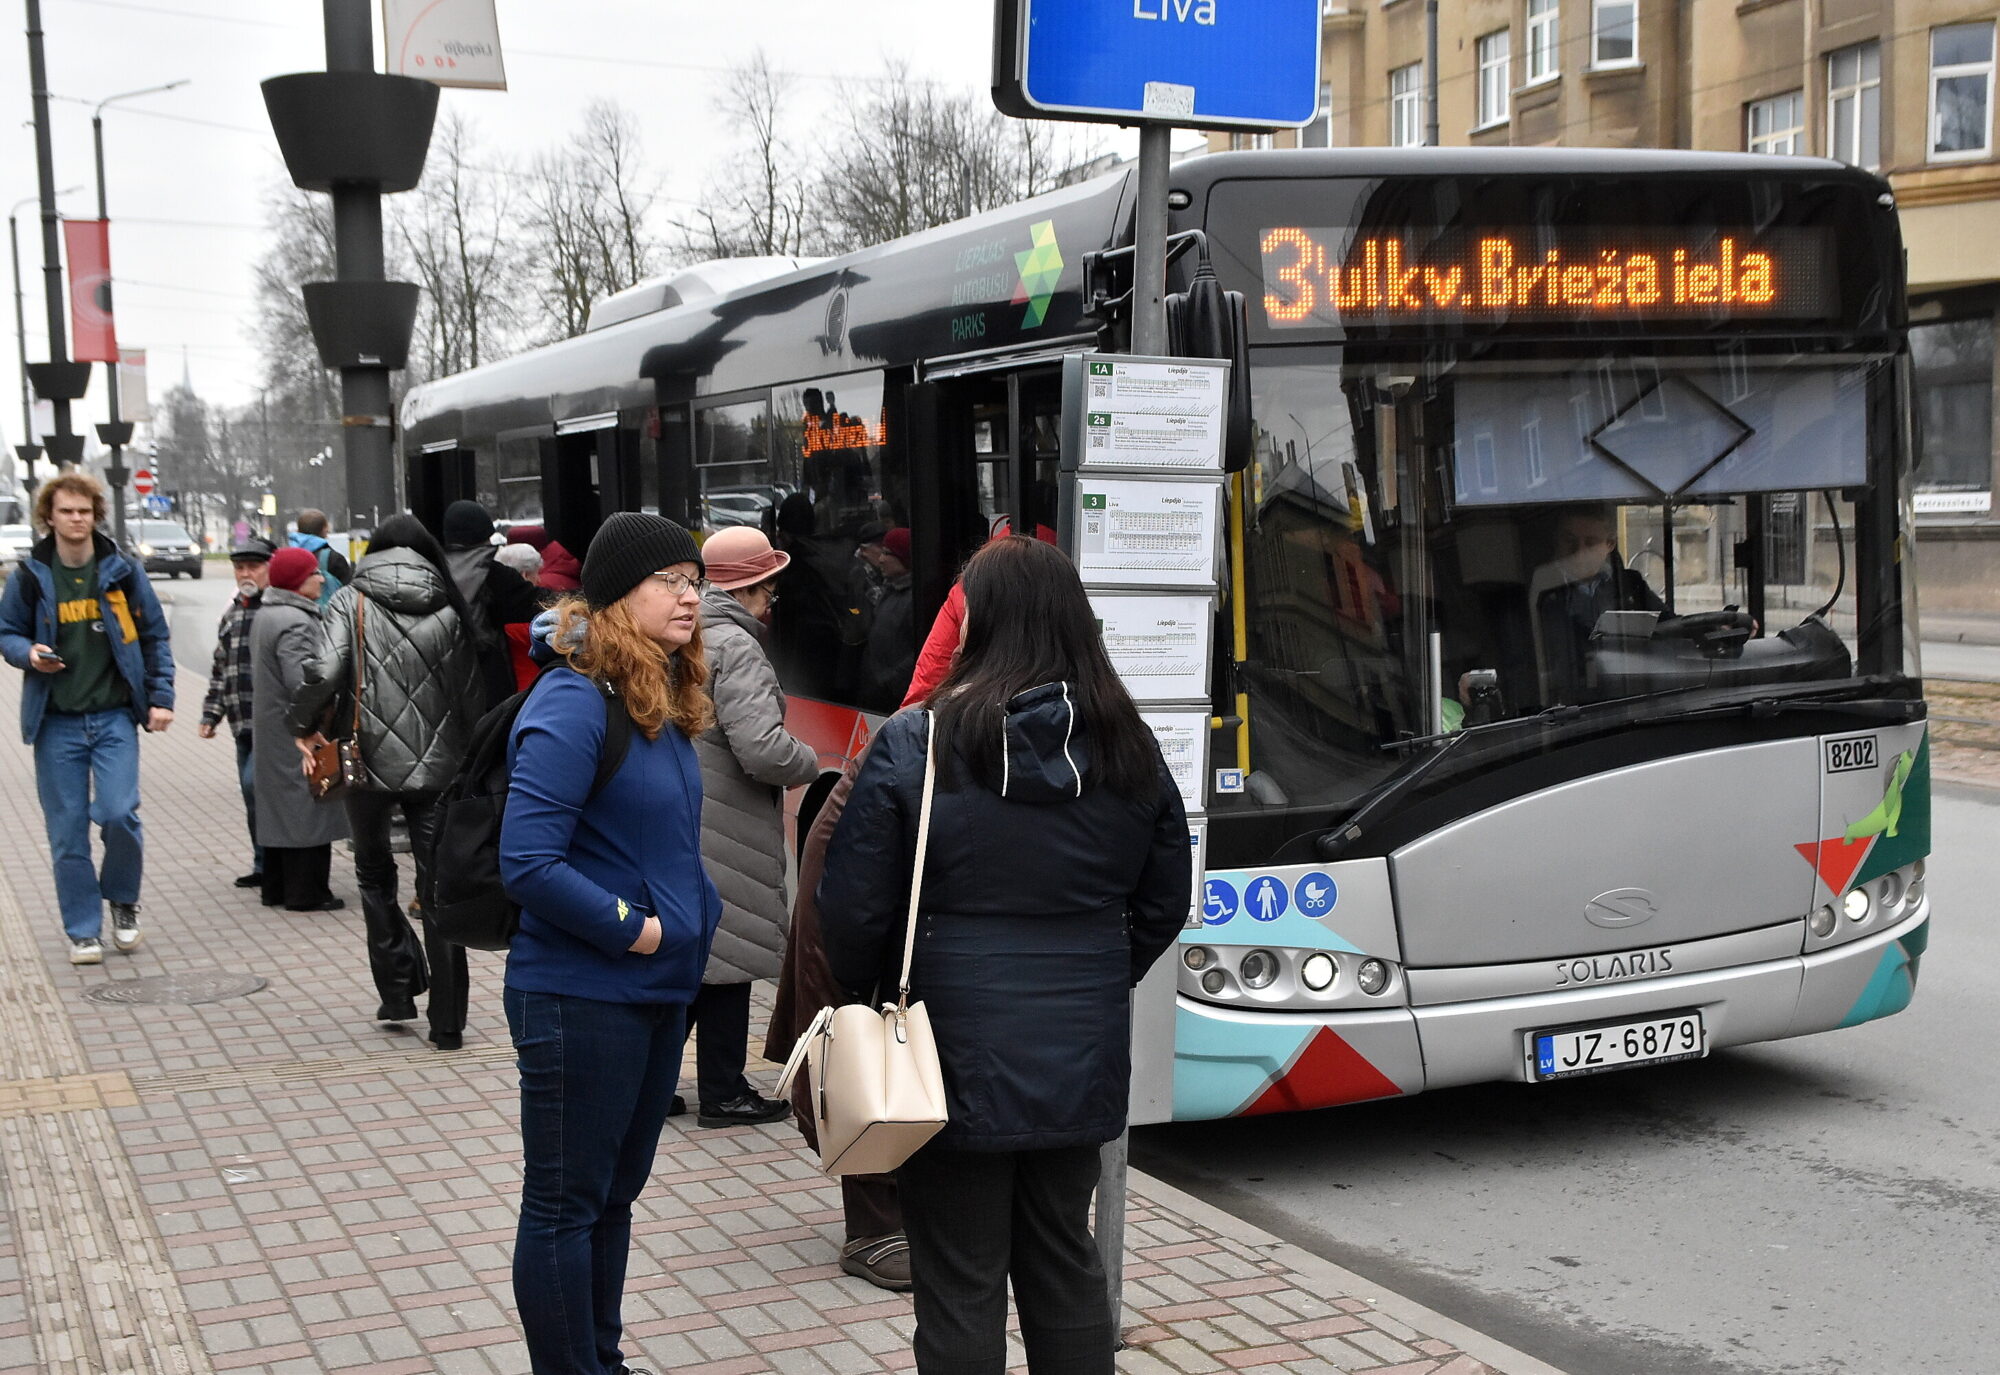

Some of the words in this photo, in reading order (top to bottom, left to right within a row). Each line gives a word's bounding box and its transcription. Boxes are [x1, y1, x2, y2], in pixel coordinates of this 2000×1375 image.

[1262, 230, 1314, 320] 3
[1674, 237, 1774, 304] iela
[952, 312, 985, 341] PARKS
[1095, 364, 1109, 375] 1A
[1091, 496, 1098, 507] 3
[1831, 740, 1874, 768] 8202
[1555, 949, 1673, 987] SOLARIS
[1562, 1020, 1695, 1067] JZ-6879
[1540, 1058, 1553, 1069] LV
